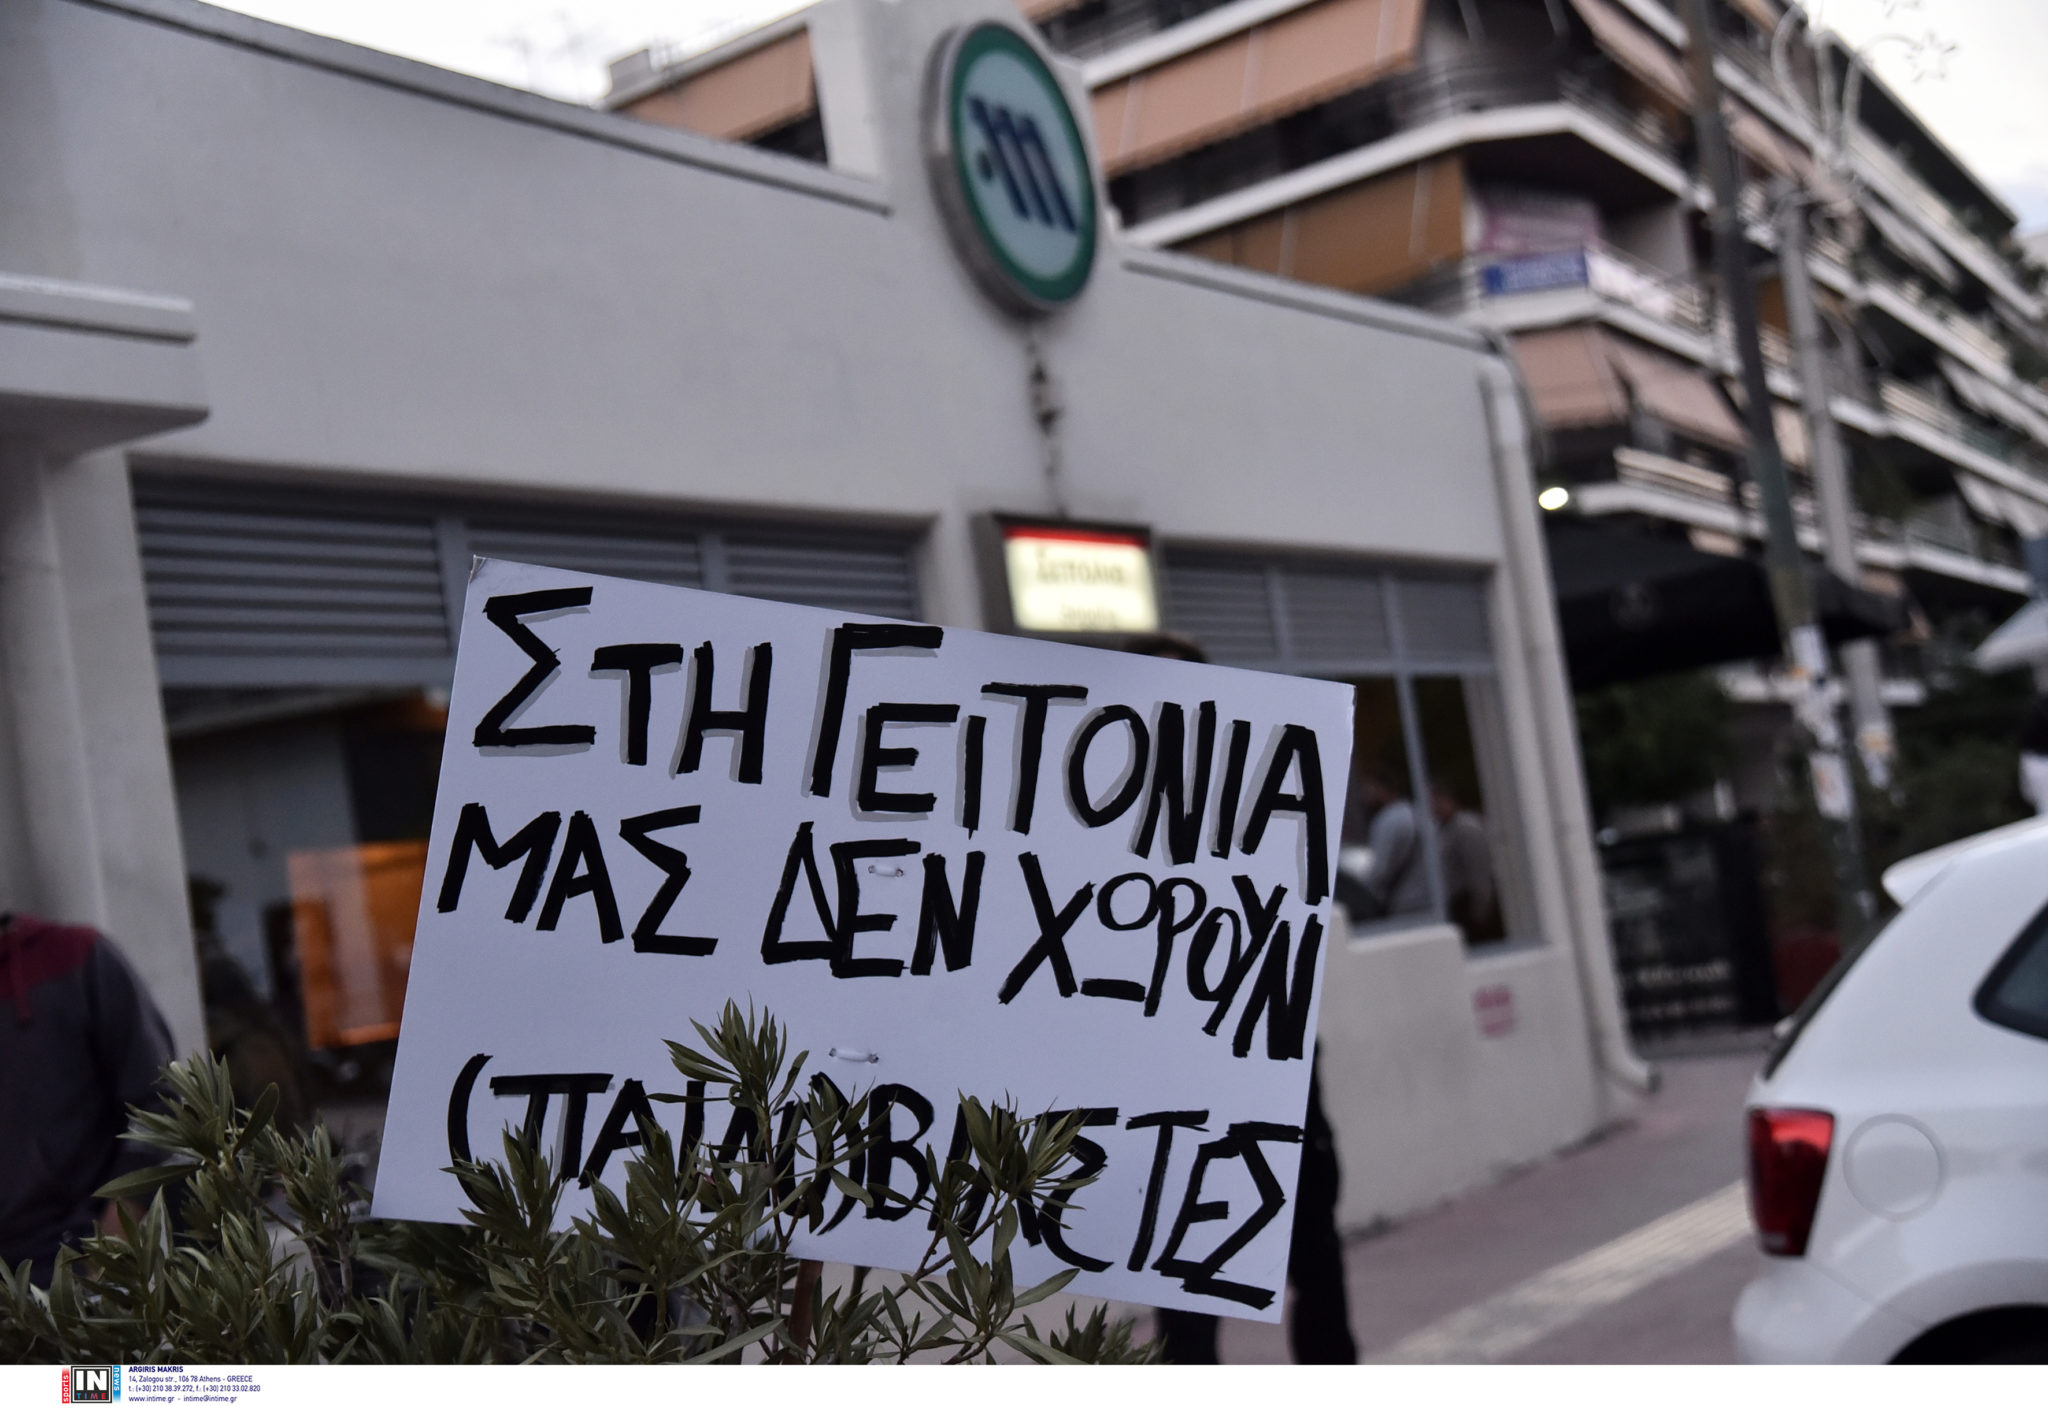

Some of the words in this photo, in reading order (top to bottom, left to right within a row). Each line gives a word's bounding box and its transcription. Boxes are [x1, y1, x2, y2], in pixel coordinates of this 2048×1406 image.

[473, 586, 773, 785] ΣΤΗ
[802, 622, 1330, 905] ΓΕΙΤΟΝΙΑ
[436, 802, 719, 956] ΜΑΣ
[762, 821, 986, 979] ΔΕΝ
[997, 851, 1325, 1060] ΧΩΡΟΥΝ
